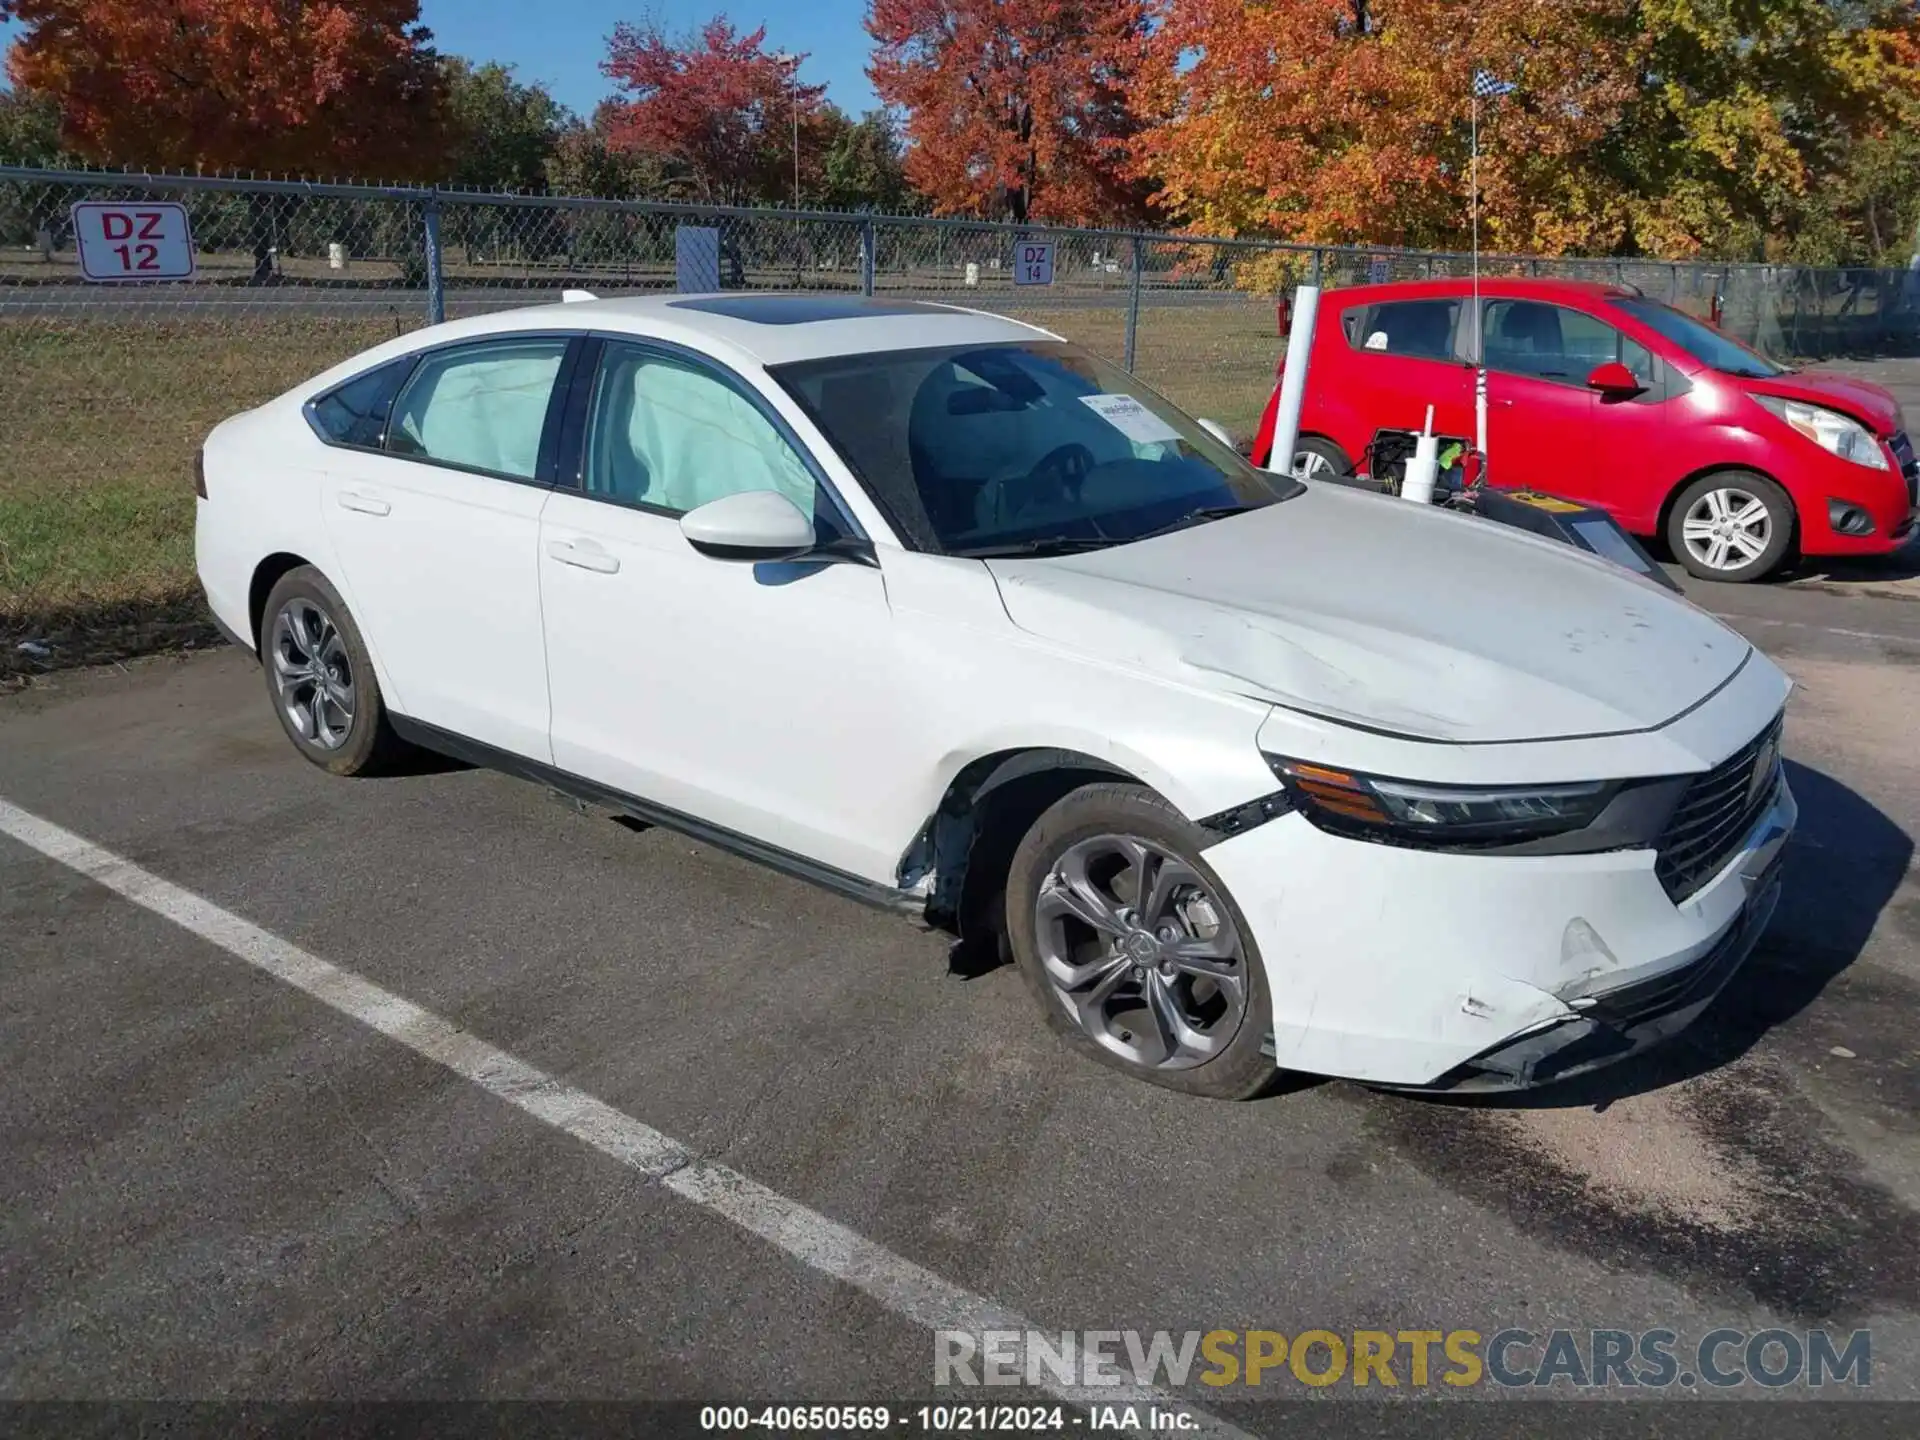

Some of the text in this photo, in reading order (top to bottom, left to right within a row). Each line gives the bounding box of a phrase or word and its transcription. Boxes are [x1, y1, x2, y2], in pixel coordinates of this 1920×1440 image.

[101, 212, 165, 240] DZ
[113, 243, 161, 270] 12
[1025, 247, 1046, 263] DZ
[1026, 265, 1041, 281] 14
